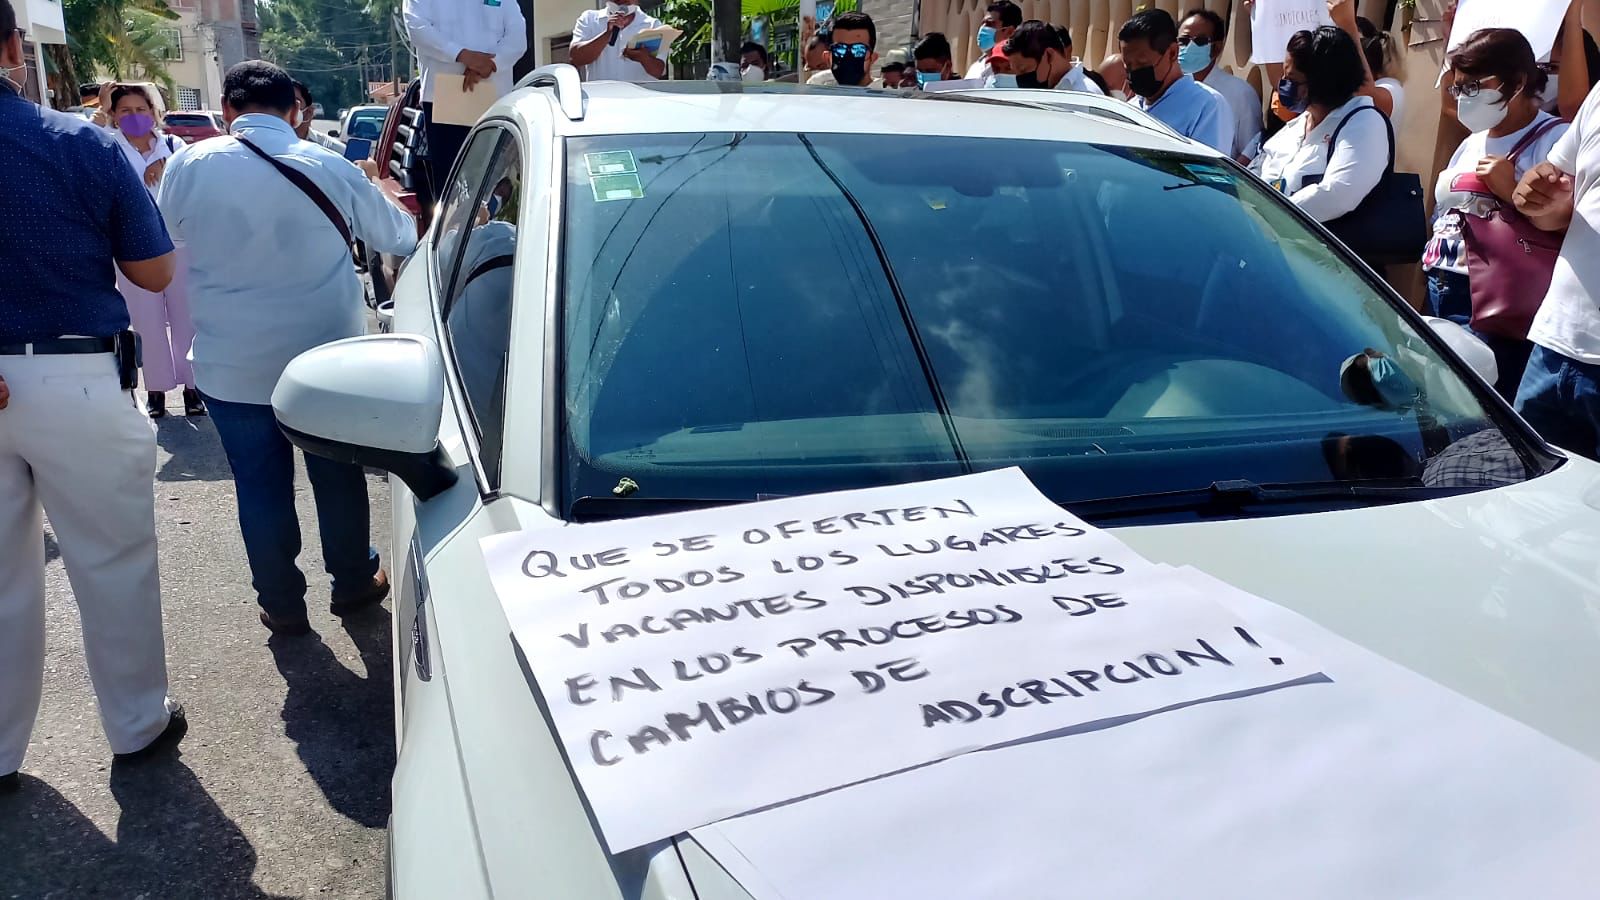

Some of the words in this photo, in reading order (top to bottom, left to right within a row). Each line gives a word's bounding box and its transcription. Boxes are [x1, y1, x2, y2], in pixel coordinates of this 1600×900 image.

[521, 546, 632, 579] QUE
[652, 534, 717, 557] SE
[742, 499, 979, 545] OFERTEN
[578, 565, 745, 605] TODOS
[772, 549, 859, 574] LOS
[877, 521, 1087, 557] LUGARES
[558, 590, 827, 649] VACANTES
[844, 557, 1125, 606] DISPONIBLES
[564, 667, 663, 706] EN
[672, 646, 763, 682] LOS
[777, 604, 1023, 658] PROCESOS
[1051, 592, 1128, 617] DE
[589, 678, 836, 767] CAMBIOS
[849, 657, 931, 694] DE
